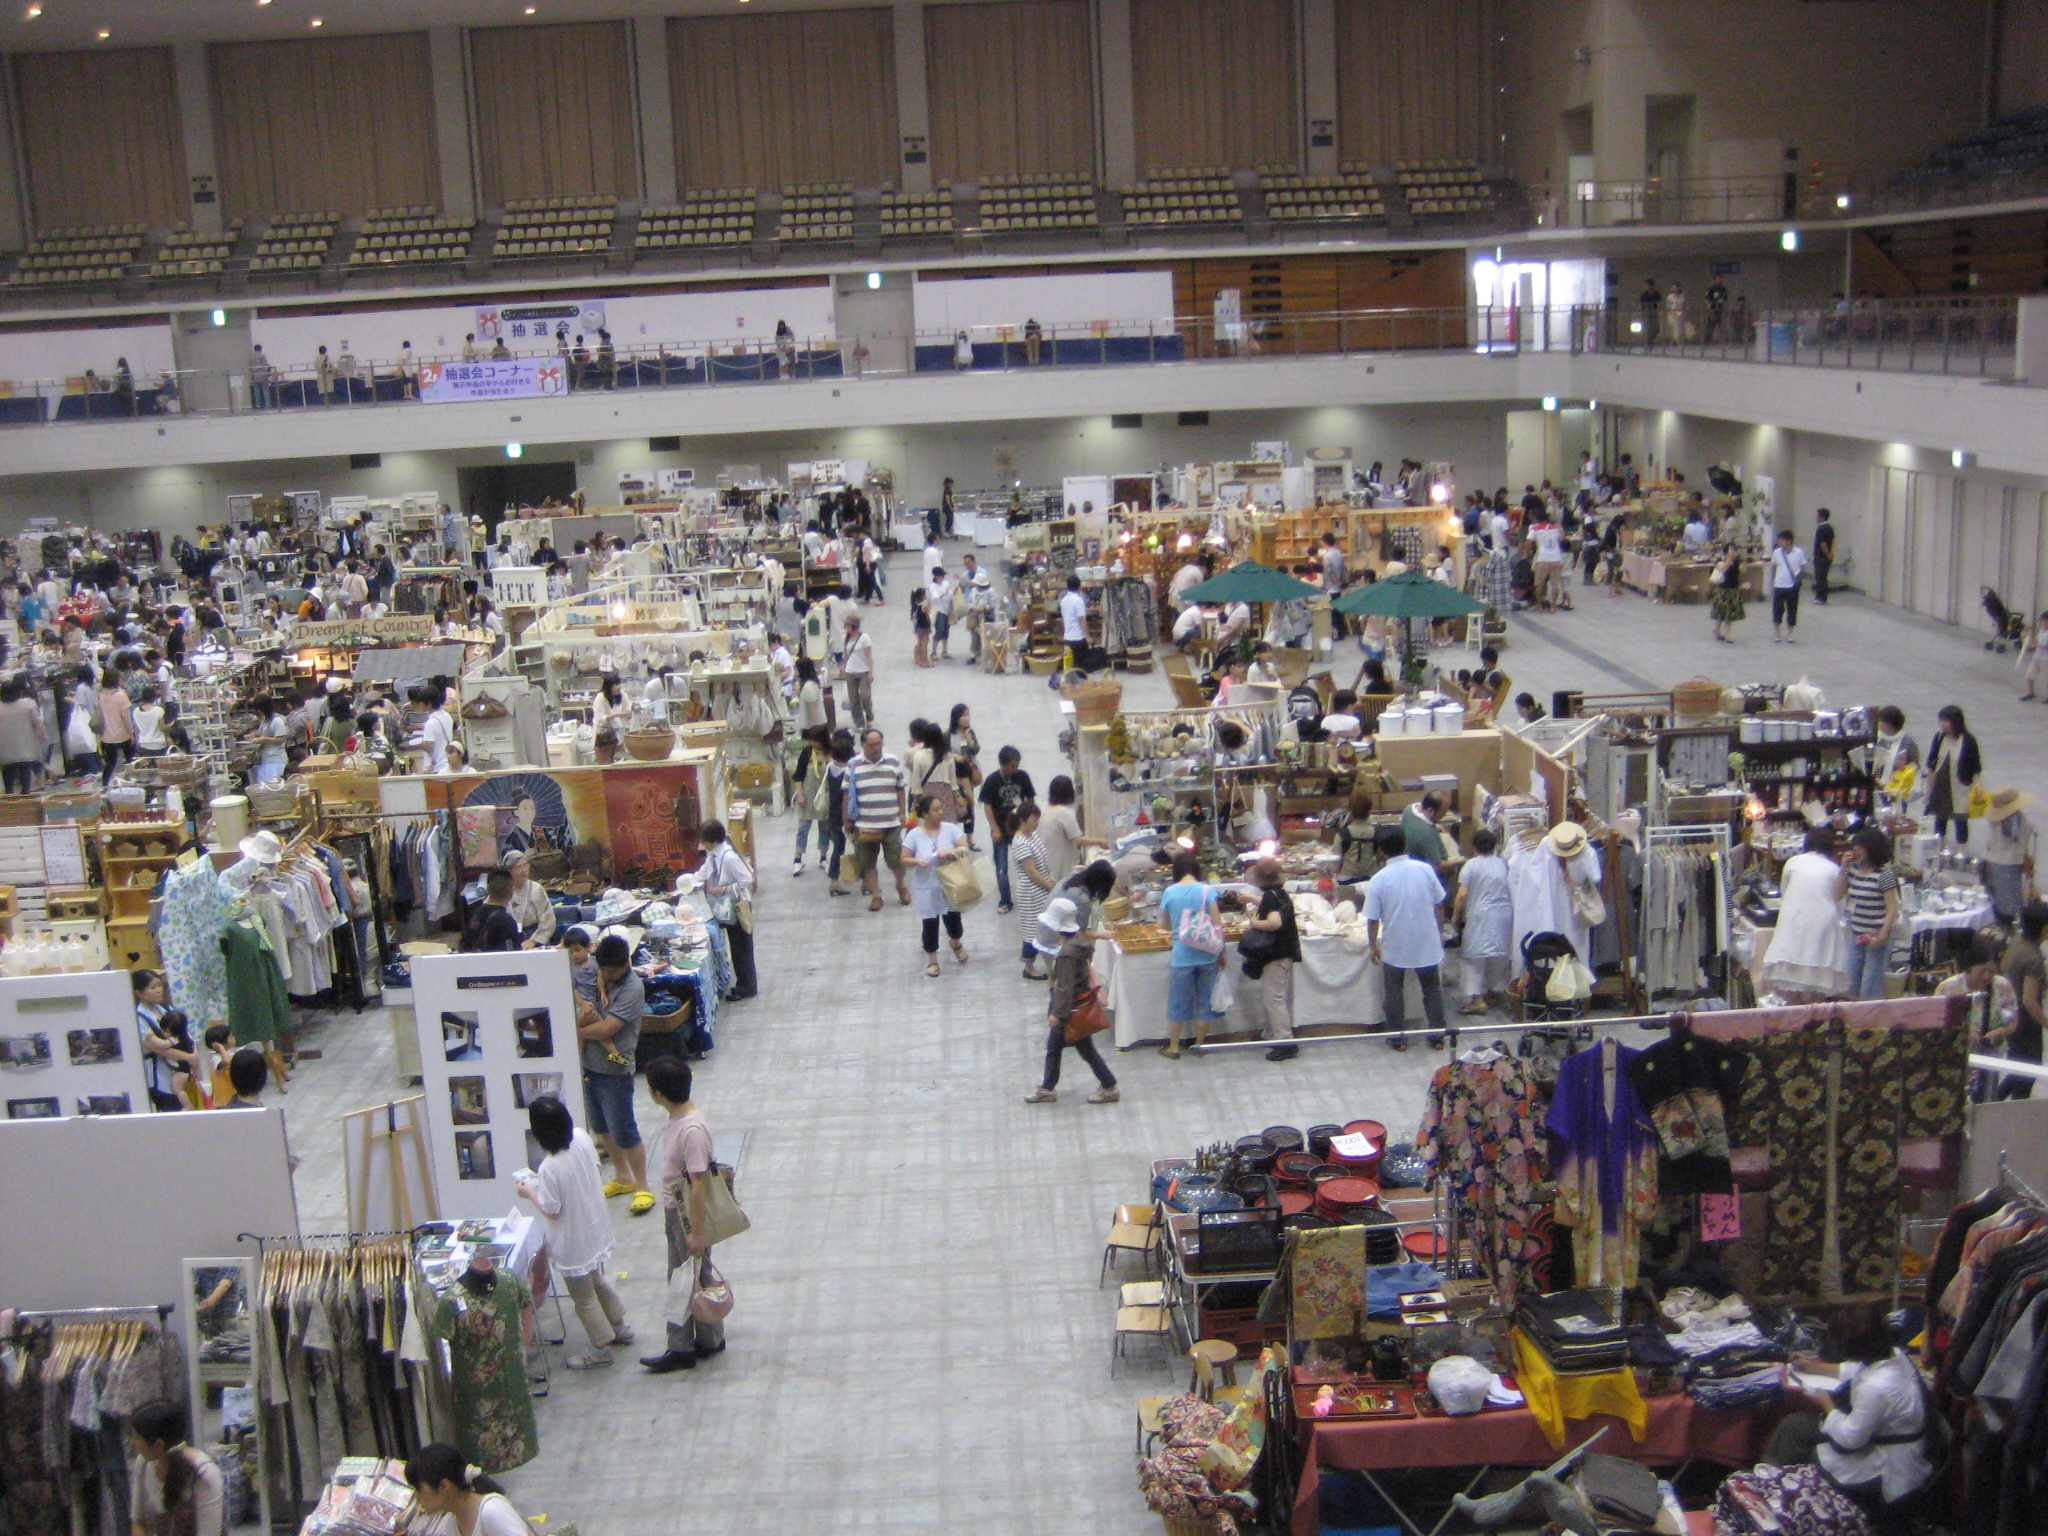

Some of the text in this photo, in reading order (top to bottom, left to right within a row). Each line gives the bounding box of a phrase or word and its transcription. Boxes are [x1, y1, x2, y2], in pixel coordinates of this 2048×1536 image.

[511, 320, 571, 338] 抽選会
[421, 368, 439, 384] 2F
[445, 364, 535, 381] 抽選会コーナー
[294, 617, 434, 640] Dream of Country
